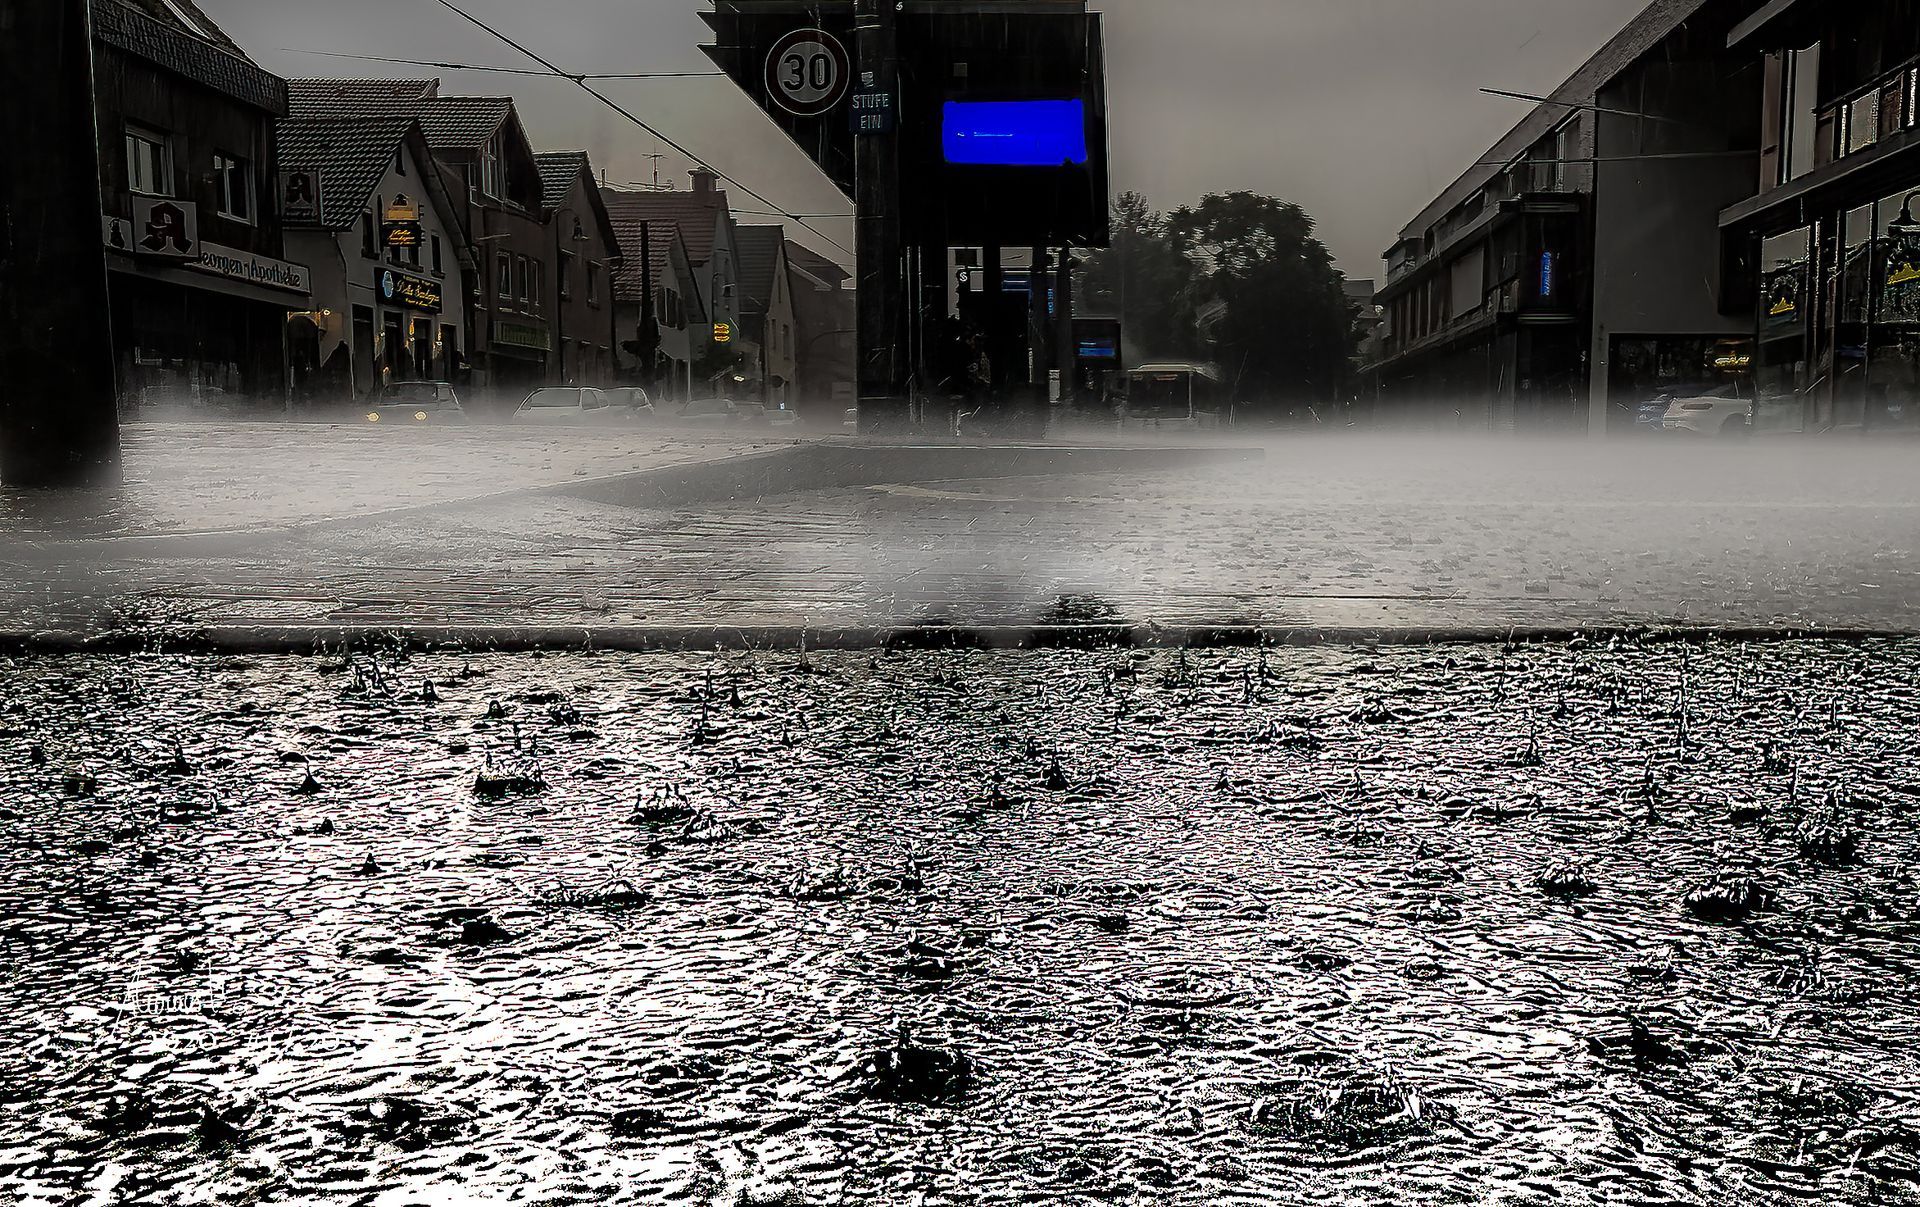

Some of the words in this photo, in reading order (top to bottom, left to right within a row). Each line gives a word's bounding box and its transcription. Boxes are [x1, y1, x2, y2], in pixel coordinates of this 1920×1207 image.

[783, 53, 832, 92] 30
[852, 93, 889, 109] STUFE
[860, 114, 881, 129] EIN
[200, 250, 302, 288] eorgen-Apotheke
